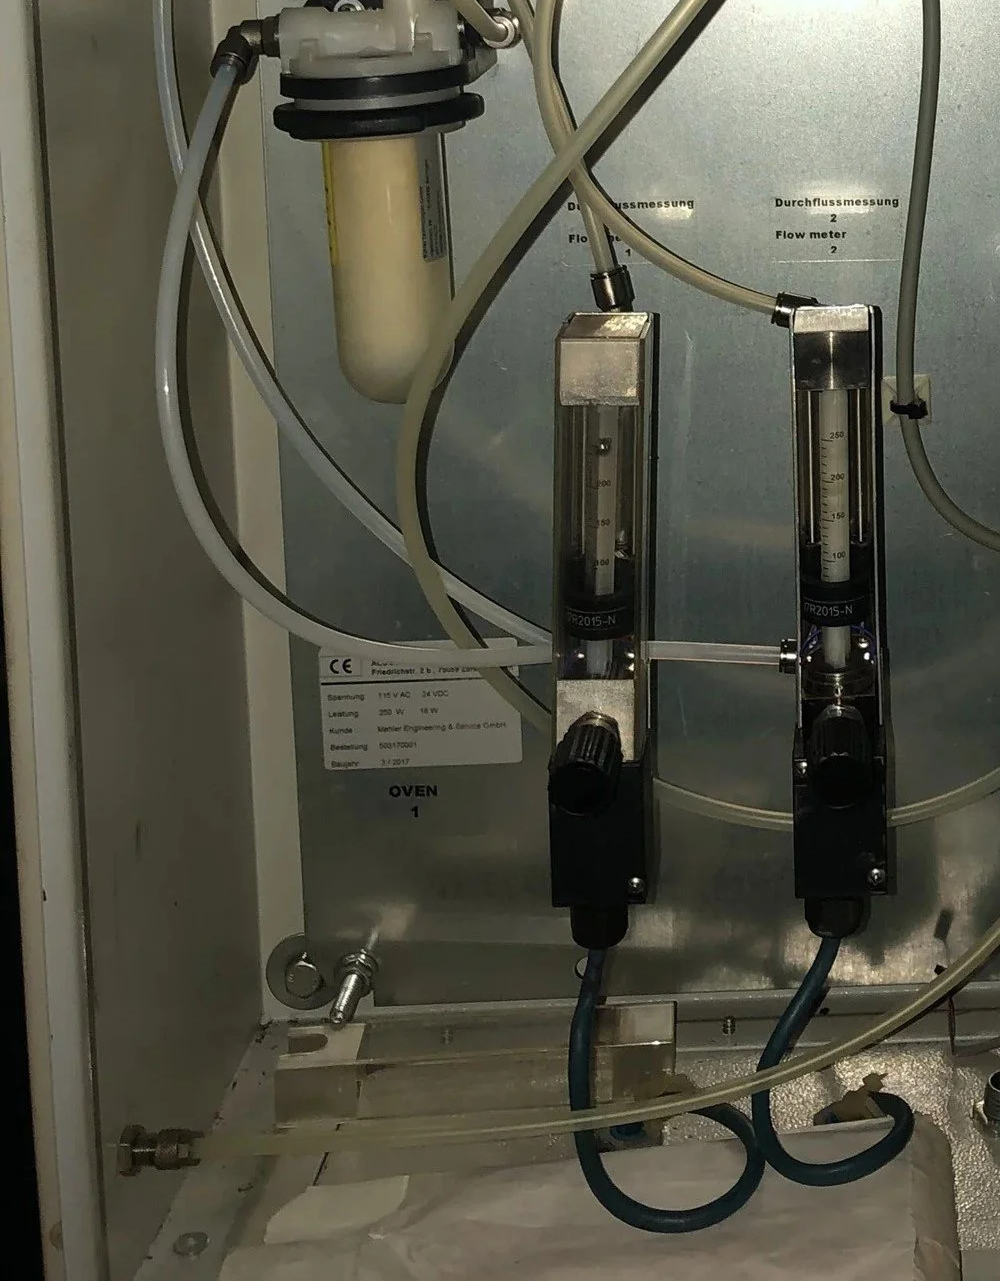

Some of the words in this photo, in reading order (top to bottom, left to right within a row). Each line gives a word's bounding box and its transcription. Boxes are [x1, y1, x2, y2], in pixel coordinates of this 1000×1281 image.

[775, 196, 900, 208] Durchflussmessung
[829, 213, 837, 223] 2
[775, 230, 806, 240] Flow
[809, 230, 847, 240] meter
[625, 248, 631, 257] 1
[829, 245, 837, 254] 2
[829, 430, 845, 440] 250
[832, 550, 846, 559] 100
[388, 785, 439, 798] OVEN
[411, 806, 419, 818] 1
